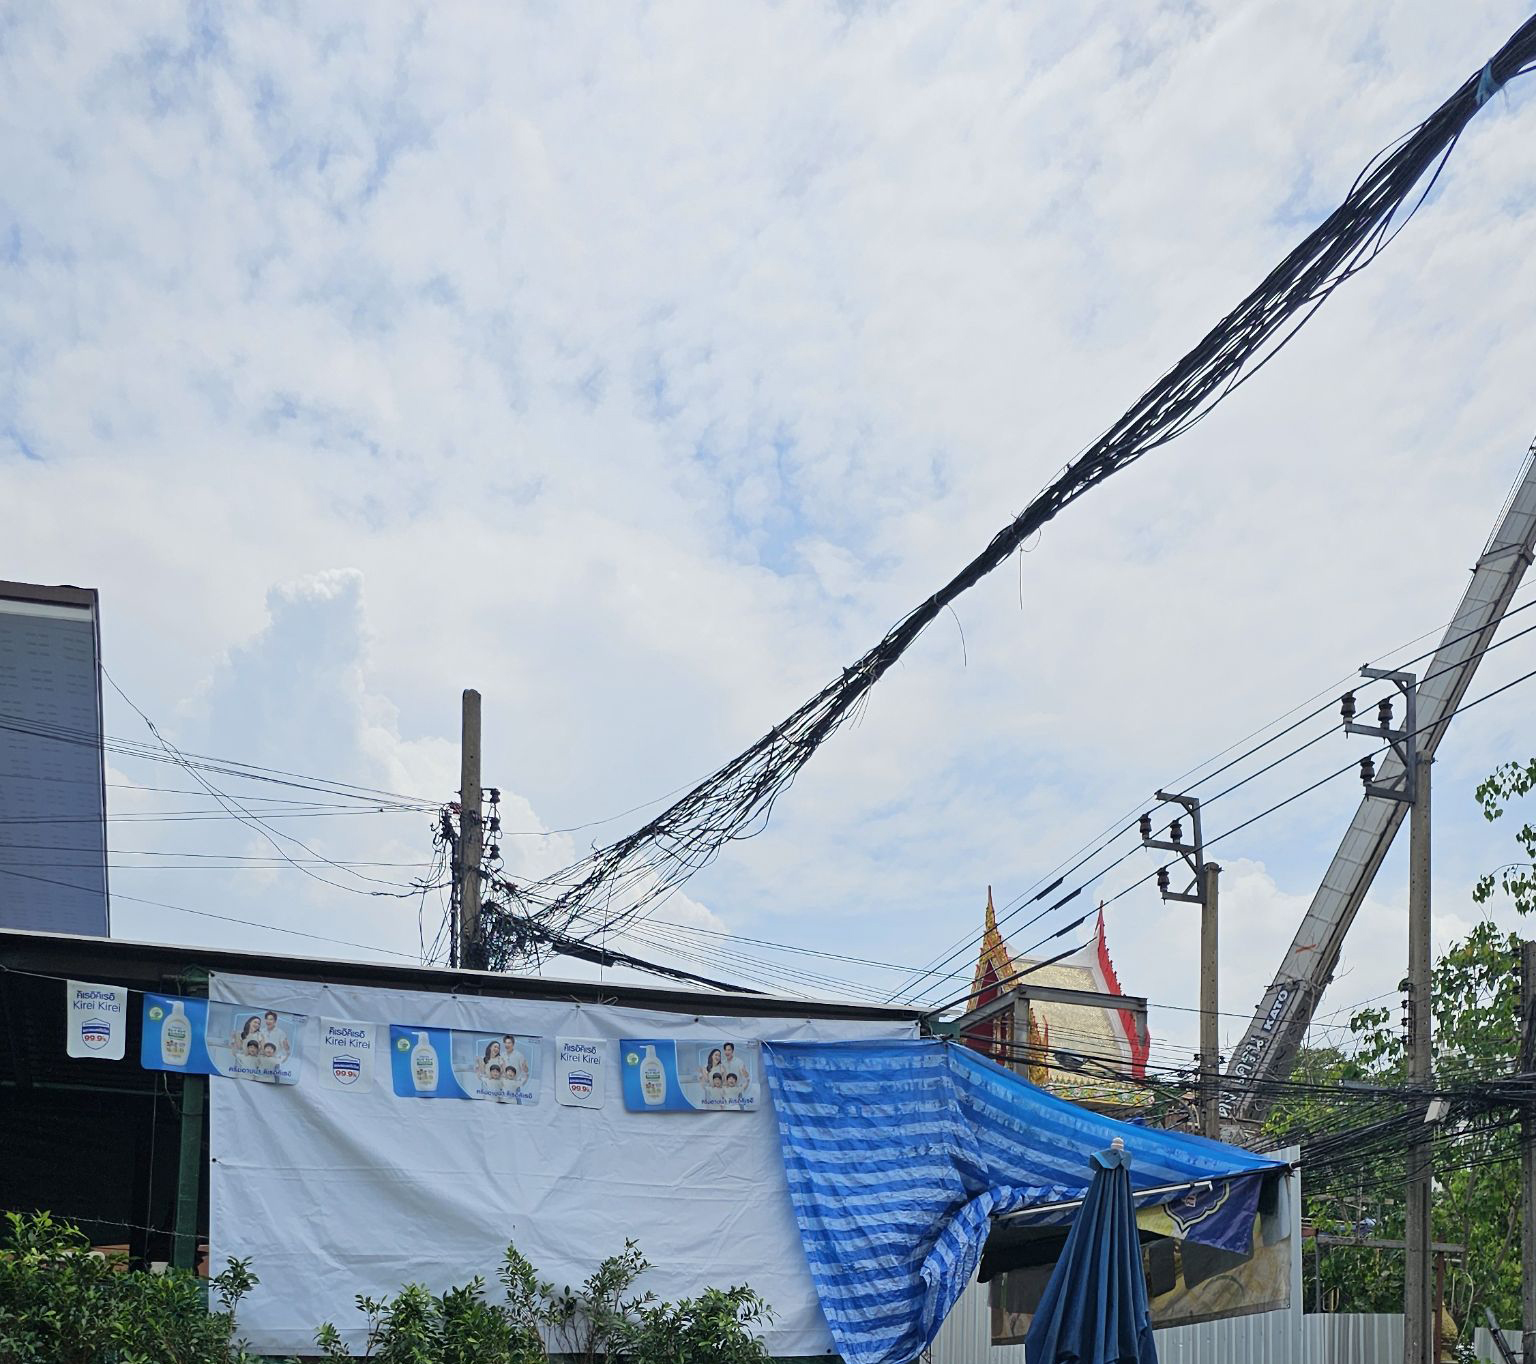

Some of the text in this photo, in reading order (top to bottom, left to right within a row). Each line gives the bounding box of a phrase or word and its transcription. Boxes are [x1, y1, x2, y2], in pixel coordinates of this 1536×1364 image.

[73, 999, 121, 1013] Kirei Kirei
[1263, 989, 1289, 1031] KATO
[325, 1036, 371, 1050] Kirei Kirei
[560, 1052, 601, 1065] Kirei Kirei
